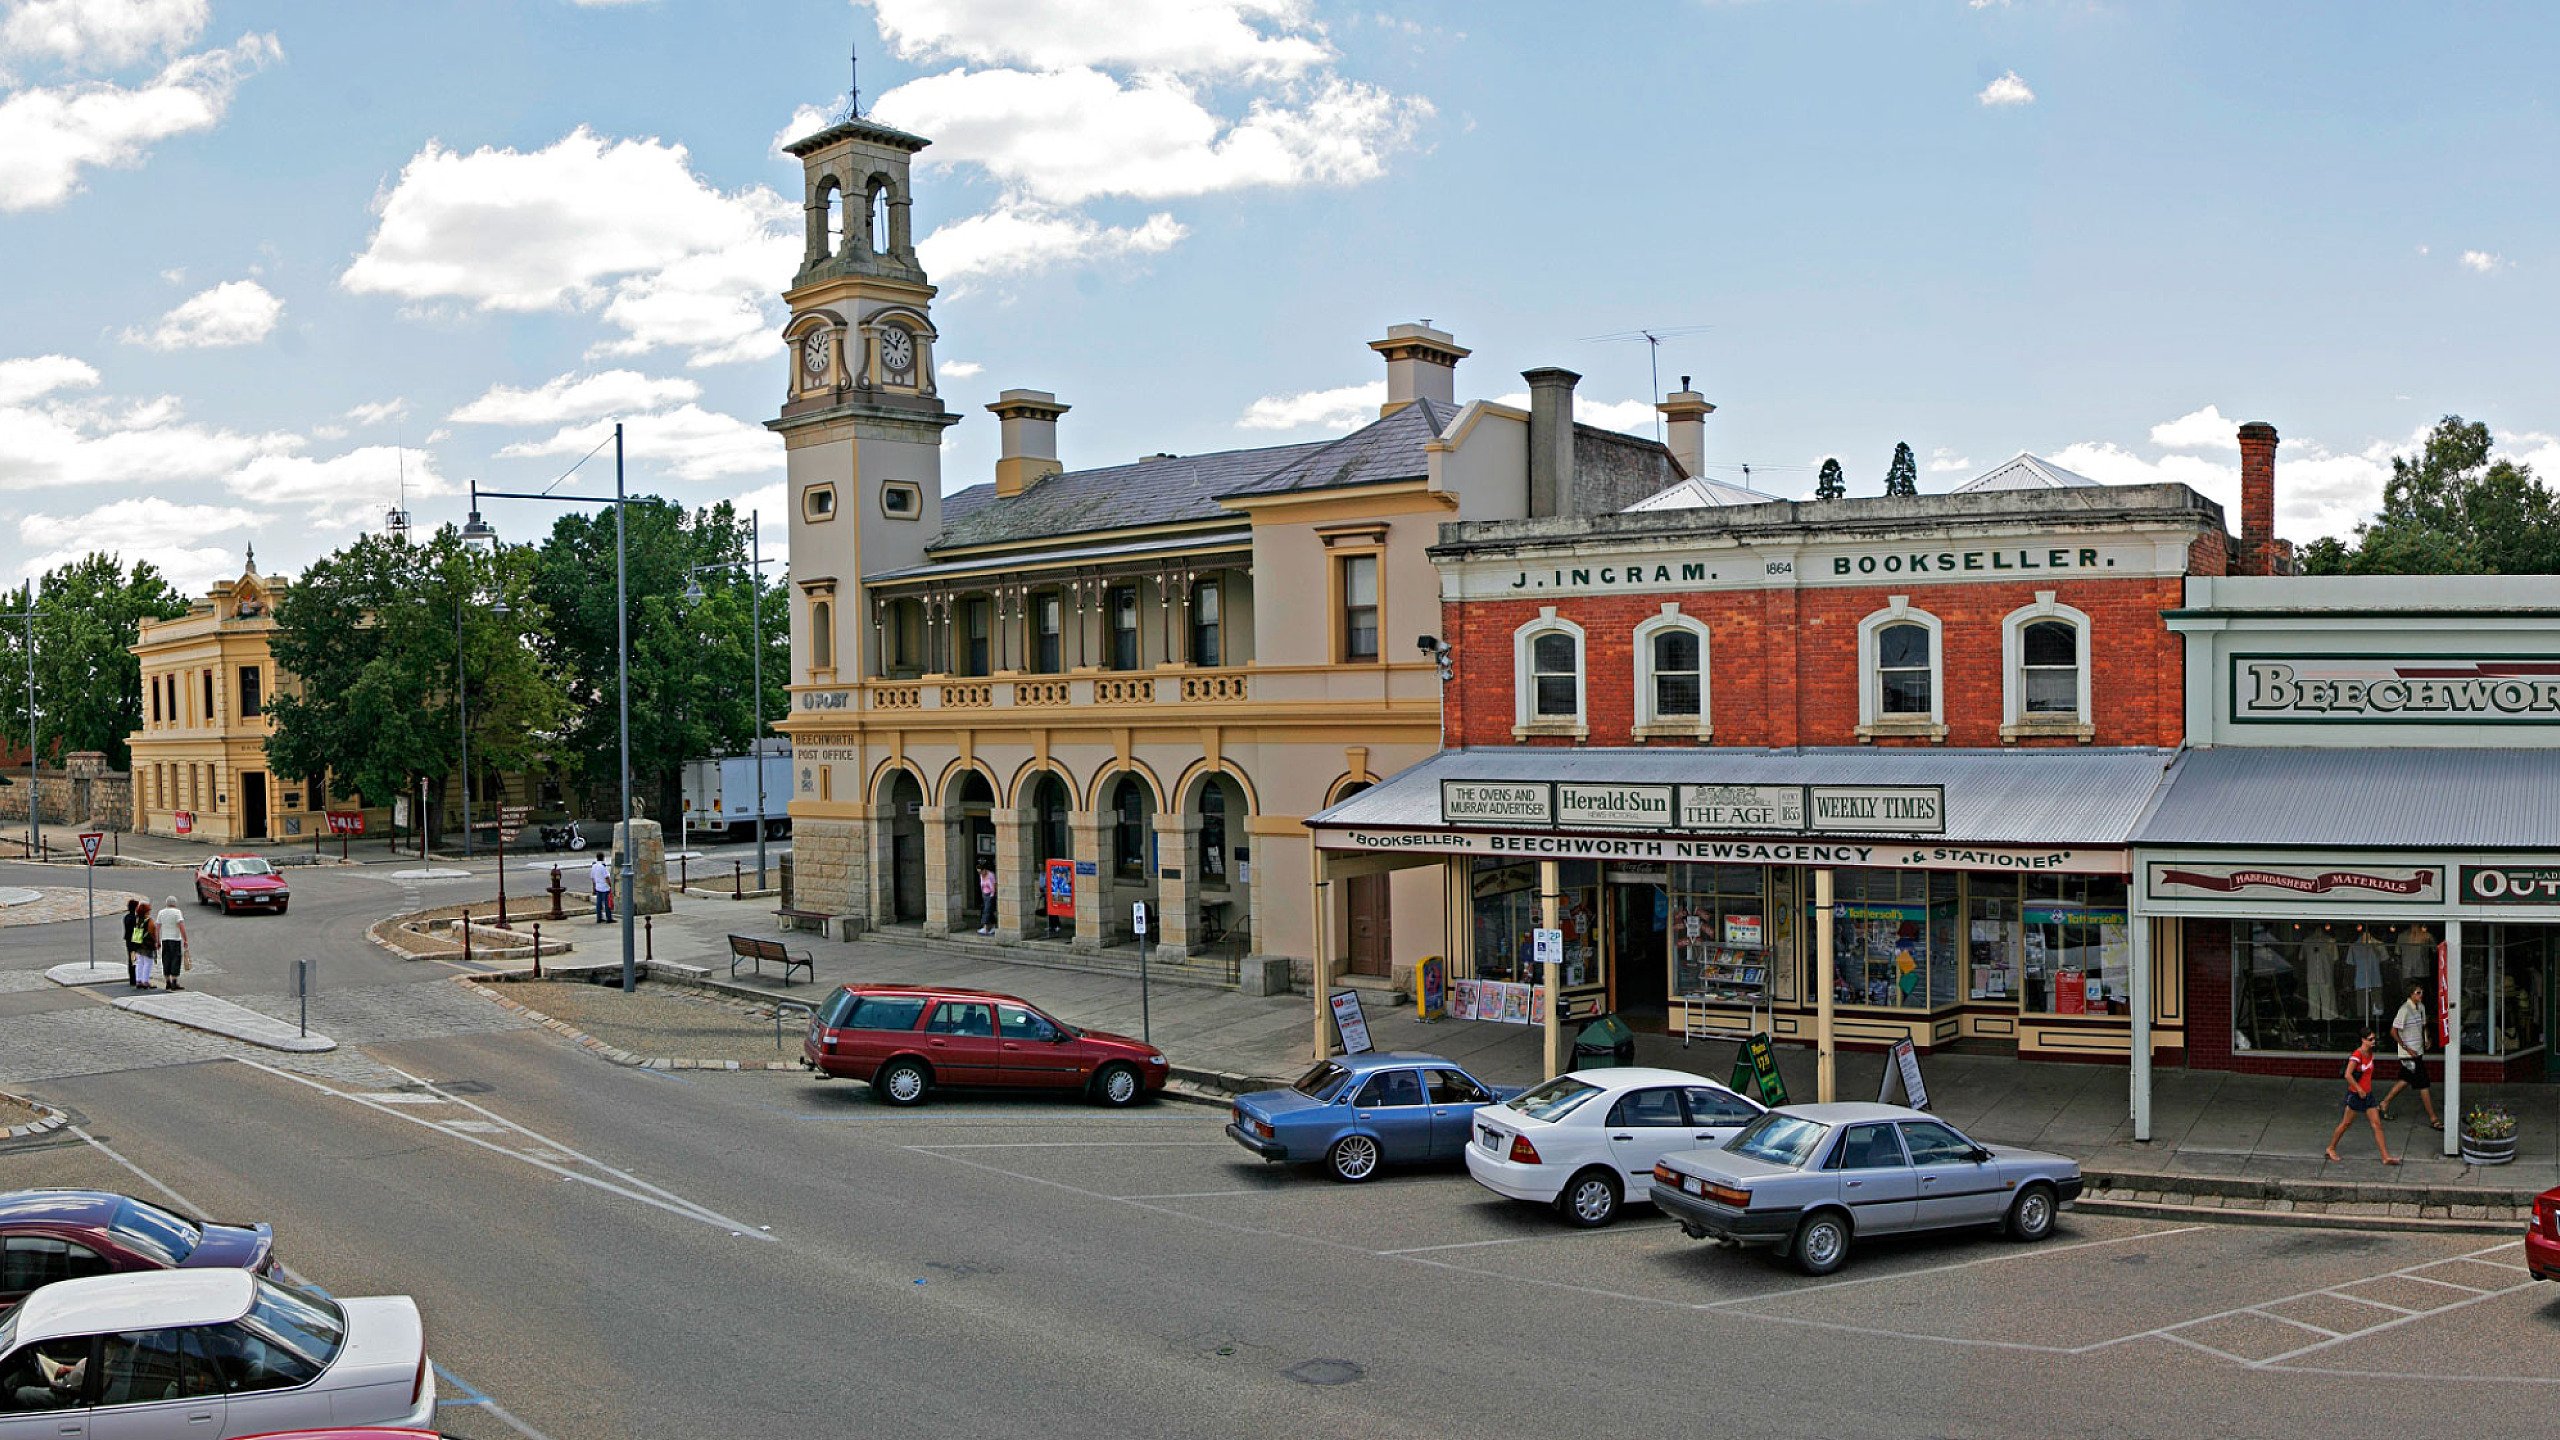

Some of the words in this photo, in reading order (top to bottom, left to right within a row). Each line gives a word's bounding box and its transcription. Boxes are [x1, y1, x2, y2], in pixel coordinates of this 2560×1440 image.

[1765, 562, 1792, 575] 1864
[1833, 548, 2115, 575] BOOKSELLER.
[815, 693, 848, 708] POST
[796, 734, 855, 745] BEECHWORTH
[798, 750, 818, 760] POST
[1456, 788, 1475, 801] THE
[1479, 788, 1512, 801] OVENS
[1514, 789, 1535, 801] AND
[1451, 802, 1487, 814] MURRAY
[1488, 803, 1545, 815] ADVERTISER
[1684, 807, 1726, 823] THE
[1731, 808, 1775, 824] AGE
[1816, 796, 1876, 819] WEEKLY
[1884, 797, 1936, 820] TIMES
[1490, 836, 1662, 856] BEECHWORTH
[1677, 843, 1873, 862] NEWSAGENCY
[1933, 848, 2062, 868] STATIONER
[2235, 873, 2316, 891] HABERDASHERY
[2331, 875, 2408, 892] MATERIALS
